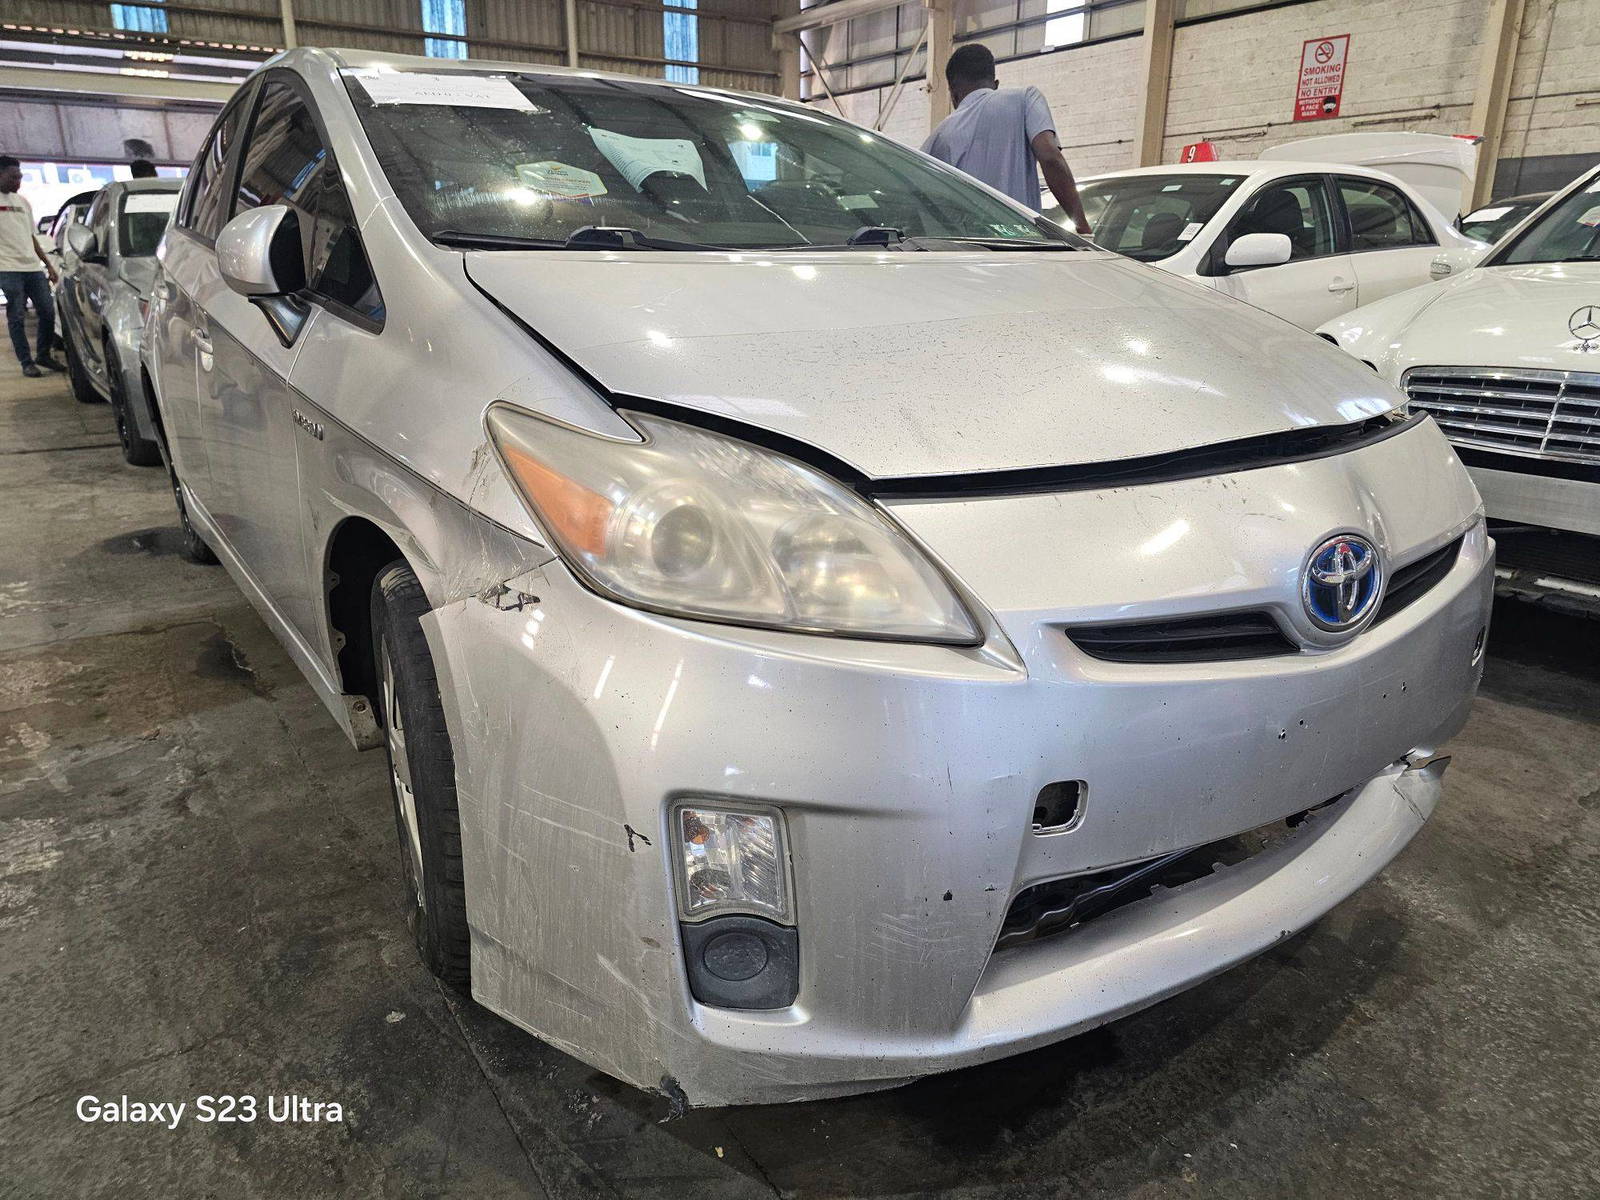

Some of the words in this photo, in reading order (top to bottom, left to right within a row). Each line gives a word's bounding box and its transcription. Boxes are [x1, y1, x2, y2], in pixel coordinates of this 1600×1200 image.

[1304, 64, 1341, 76] SMOKING
[1302, 78, 1313, 86] NOT
[1314, 75, 1340, 85] ALLOWED
[1314, 87, 1337, 95] ENTRY
[1187, 146, 1195, 162] 9
